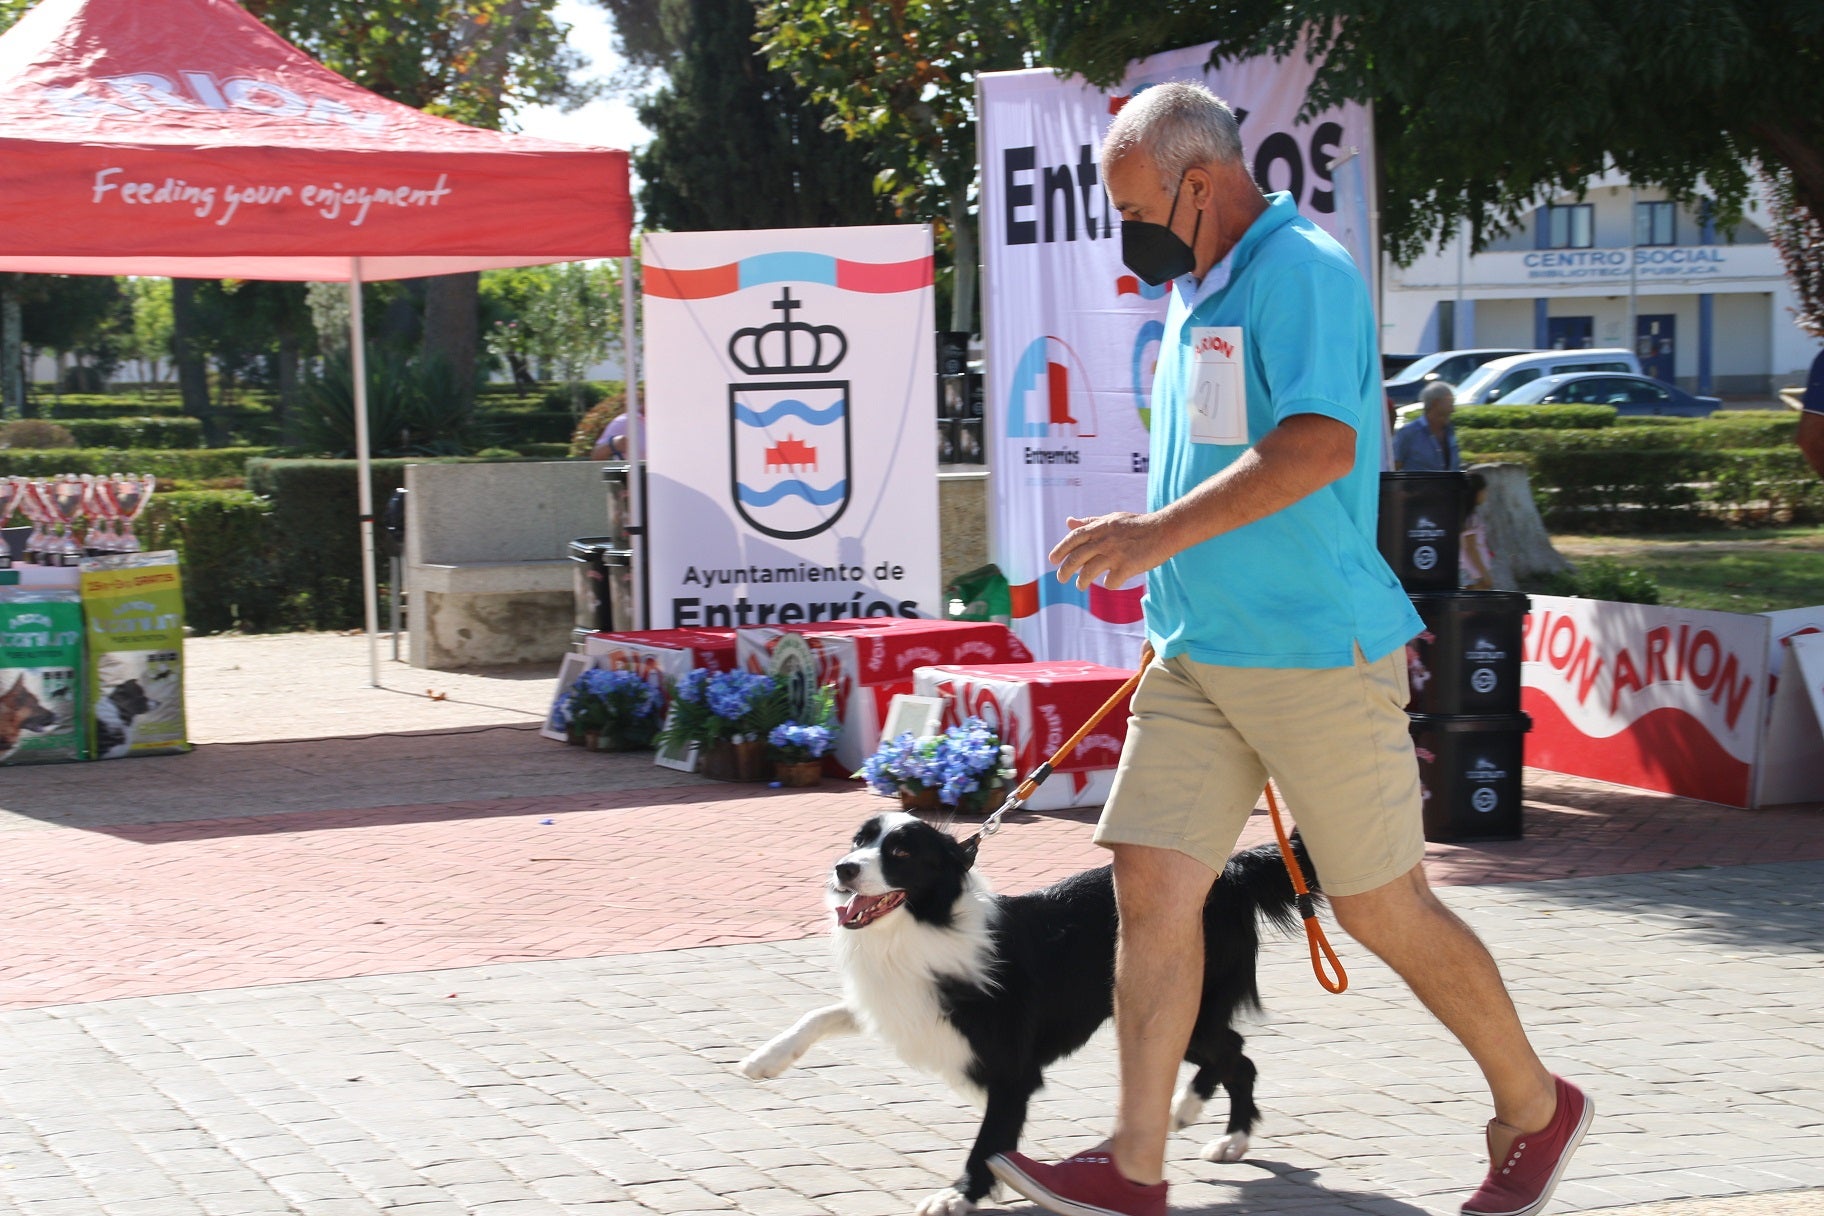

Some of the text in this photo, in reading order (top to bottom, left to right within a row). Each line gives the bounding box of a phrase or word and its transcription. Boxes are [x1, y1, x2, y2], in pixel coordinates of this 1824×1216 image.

[92, 167, 452, 226] Feeding your enjoyment
[1524, 248, 1726, 268] CENTRO SOCIAL
[683, 561, 905, 588] Ayuntamiento de
[1521, 611, 1604, 706] RION
[1609, 624, 1753, 732] ARION
